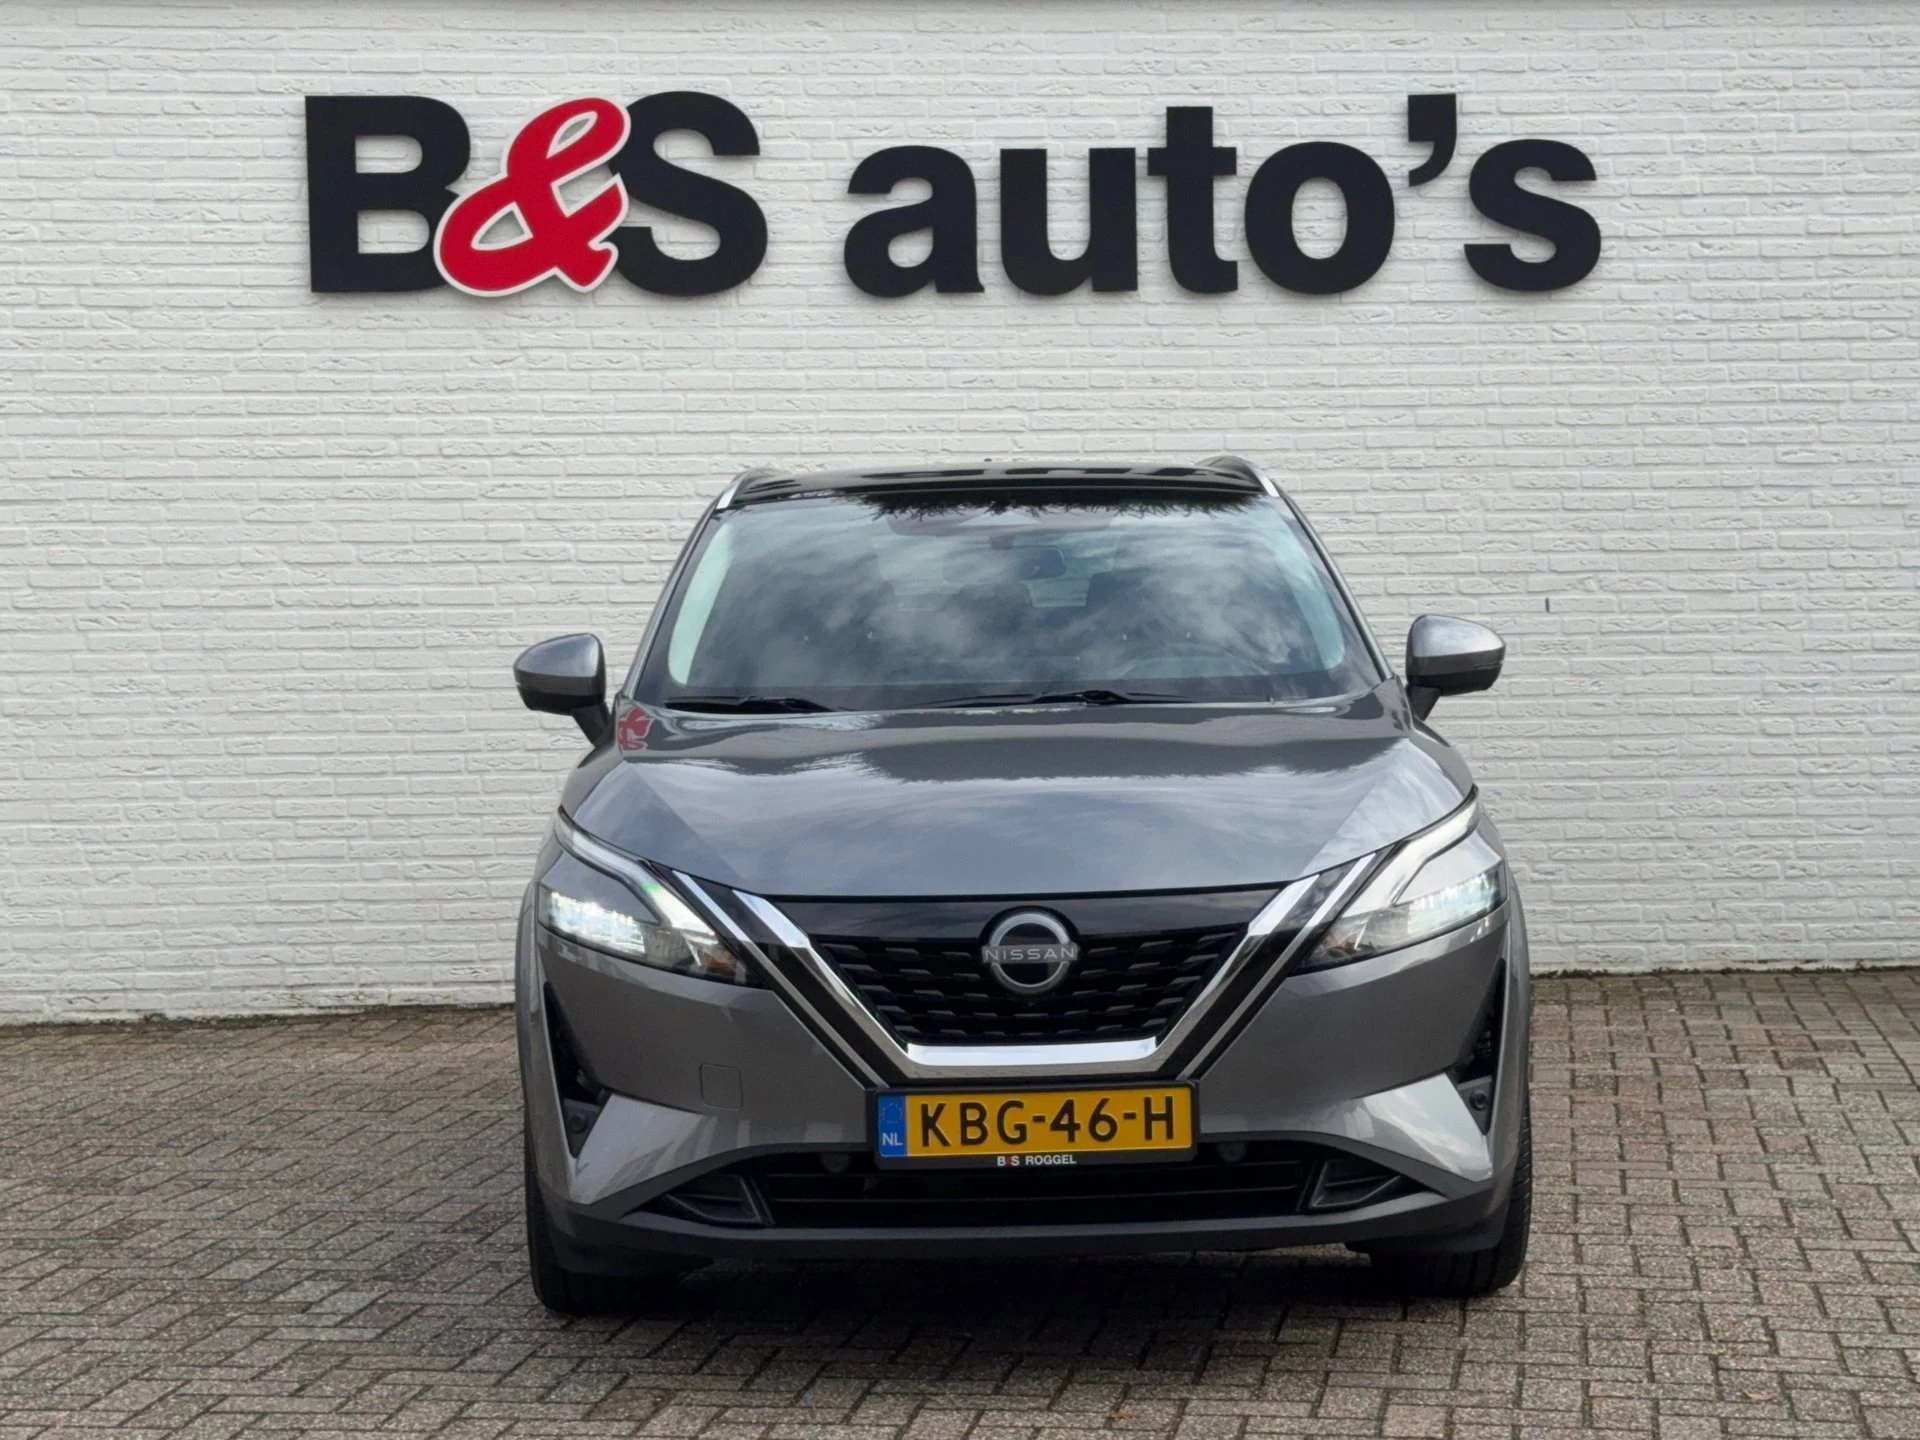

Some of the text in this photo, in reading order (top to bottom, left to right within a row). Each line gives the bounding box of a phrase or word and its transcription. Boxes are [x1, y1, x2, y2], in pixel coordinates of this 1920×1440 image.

[305, 91, 1602, 297] B&S auto's
[985, 947, 1074, 961] NISSAN
[881, 1095, 1175, 1148] NL KBG-46-H
[1025, 1154, 1077, 1166] ROGGEL
